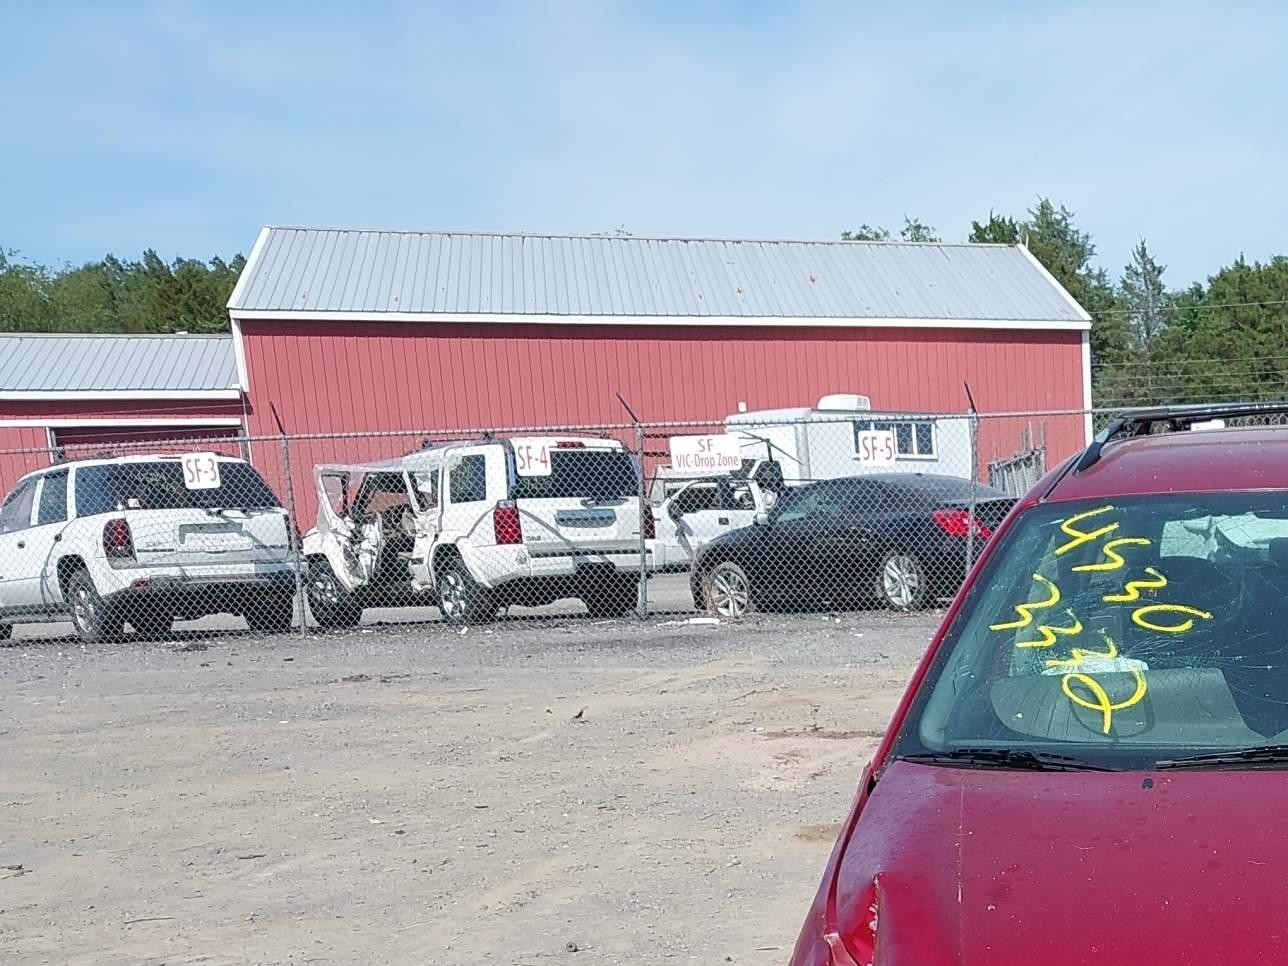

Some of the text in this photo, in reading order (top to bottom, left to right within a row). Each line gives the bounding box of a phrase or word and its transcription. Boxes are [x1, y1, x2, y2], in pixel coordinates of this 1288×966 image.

[698, 438, 714, 451] SF
[862, 436, 892, 461] SF-5
[517, 445, 549, 470] SF-4
[675, 451, 739, 469] VIC-Drop Zone
[186, 458, 217, 483] SF-3
